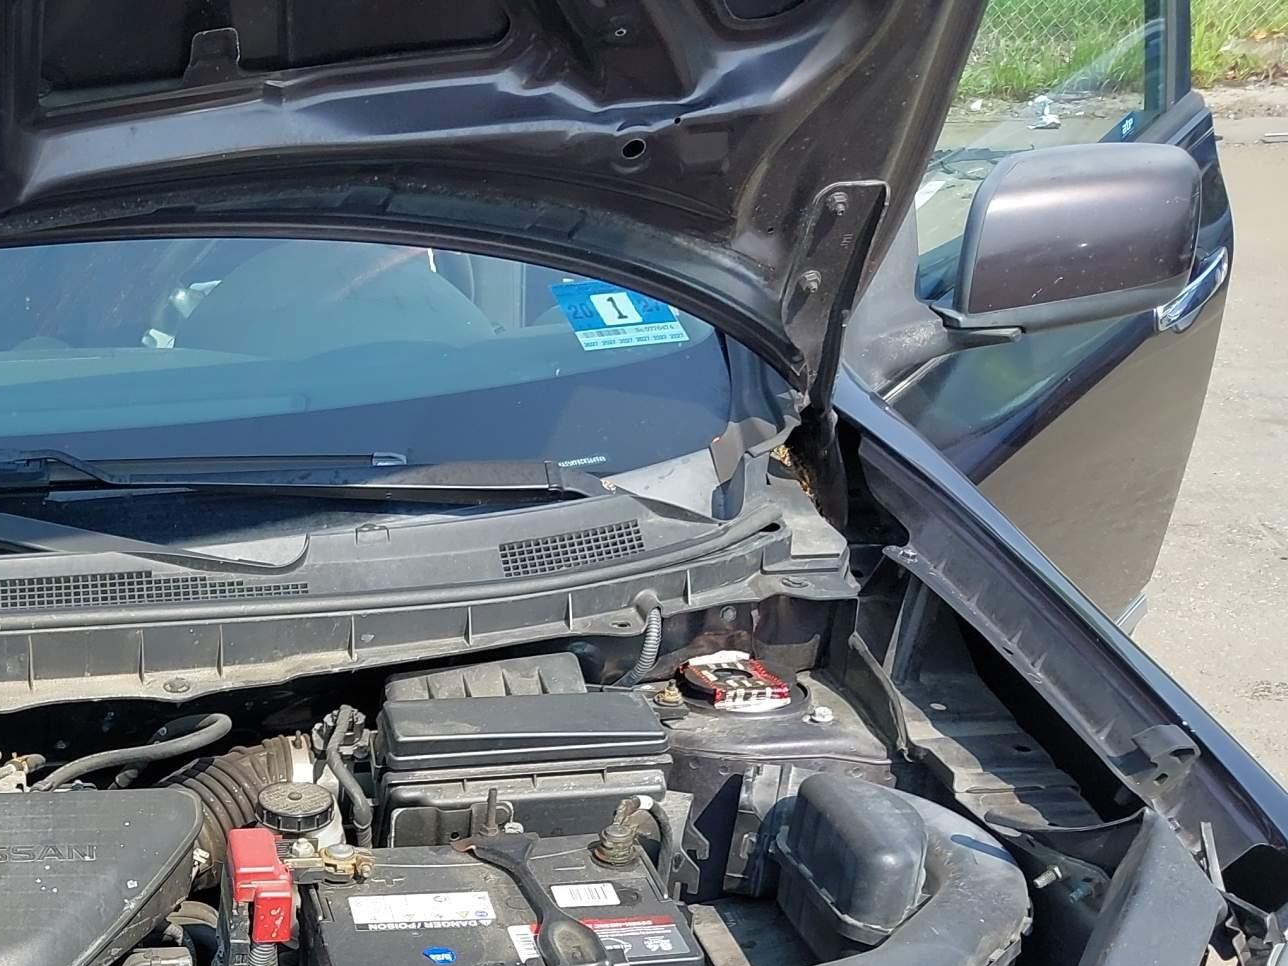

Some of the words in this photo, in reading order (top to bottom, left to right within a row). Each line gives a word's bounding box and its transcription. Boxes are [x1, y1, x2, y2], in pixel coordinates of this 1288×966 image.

[606, 297, 628, 319] 1
[368, 920, 416, 931] POISON
[424, 919, 478, 929] DANGER
